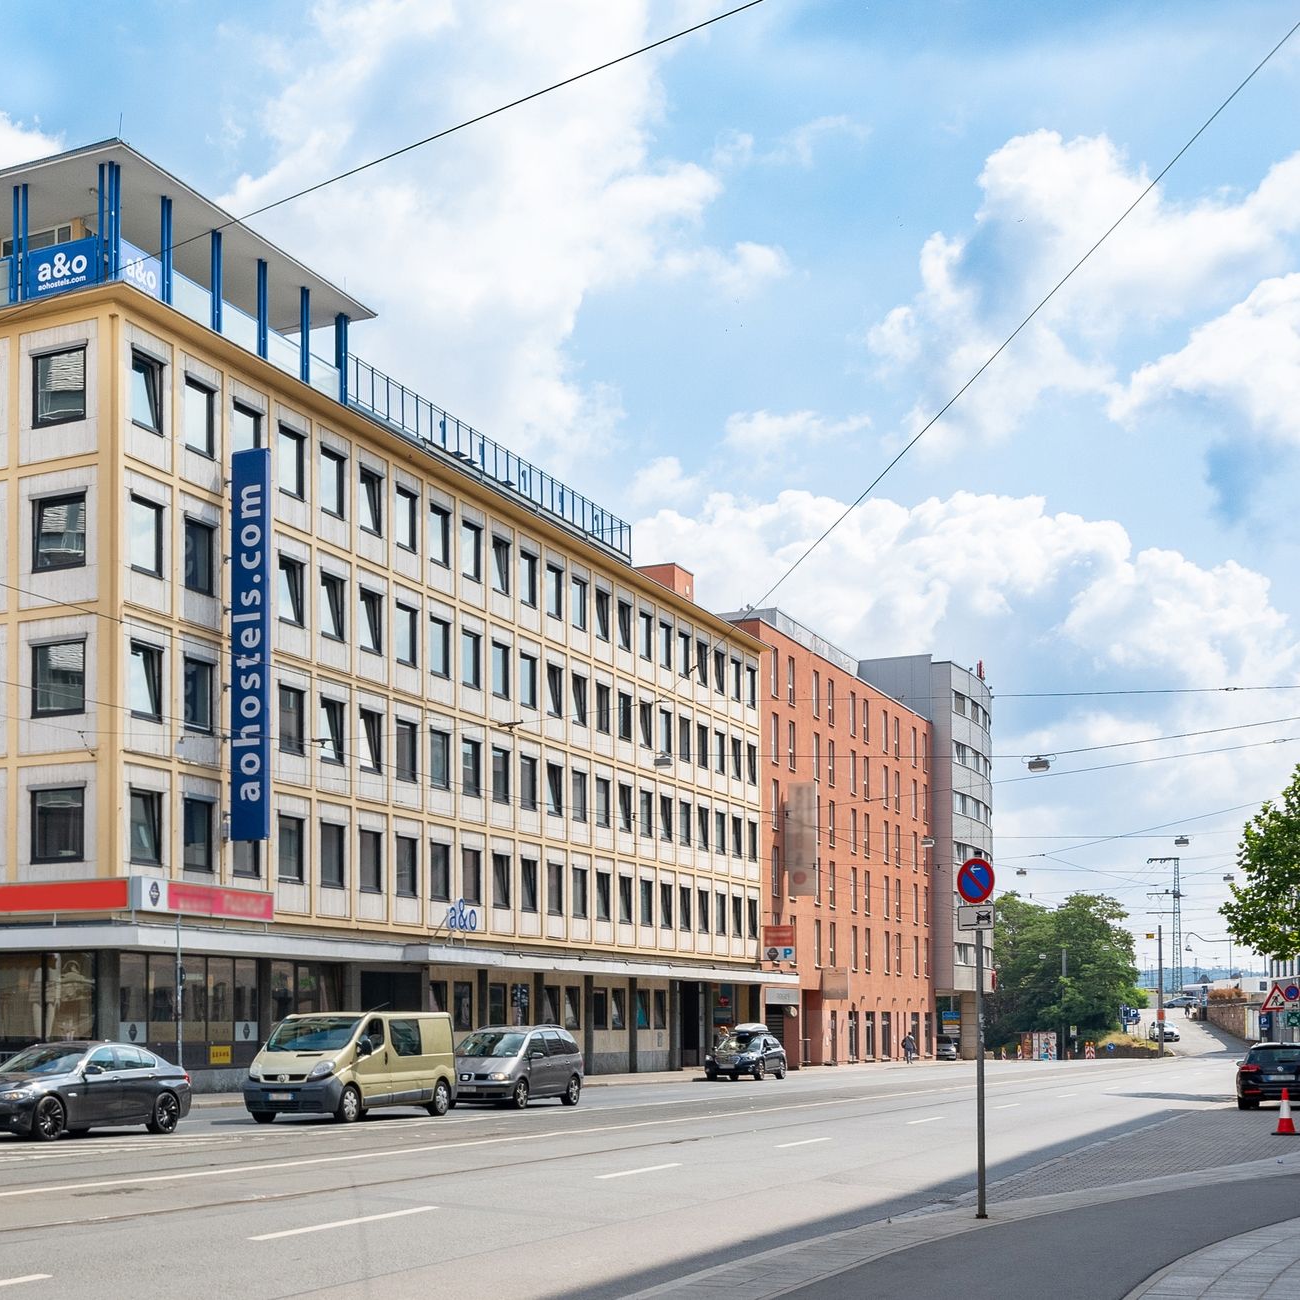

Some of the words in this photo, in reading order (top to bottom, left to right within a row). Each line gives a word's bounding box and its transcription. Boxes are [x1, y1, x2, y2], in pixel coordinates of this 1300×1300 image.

[38, 252, 88, 281] a&o
[126, 257, 157, 290] a&o
[38, 275, 86, 291] aohostels.com
[233, 484, 261, 802] aohostels.com
[448, 897, 477, 931] a&o
[783, 948, 793, 959] P
[1130, 1009, 1137, 1017] P
[1261, 1017, 1267, 1025] P
